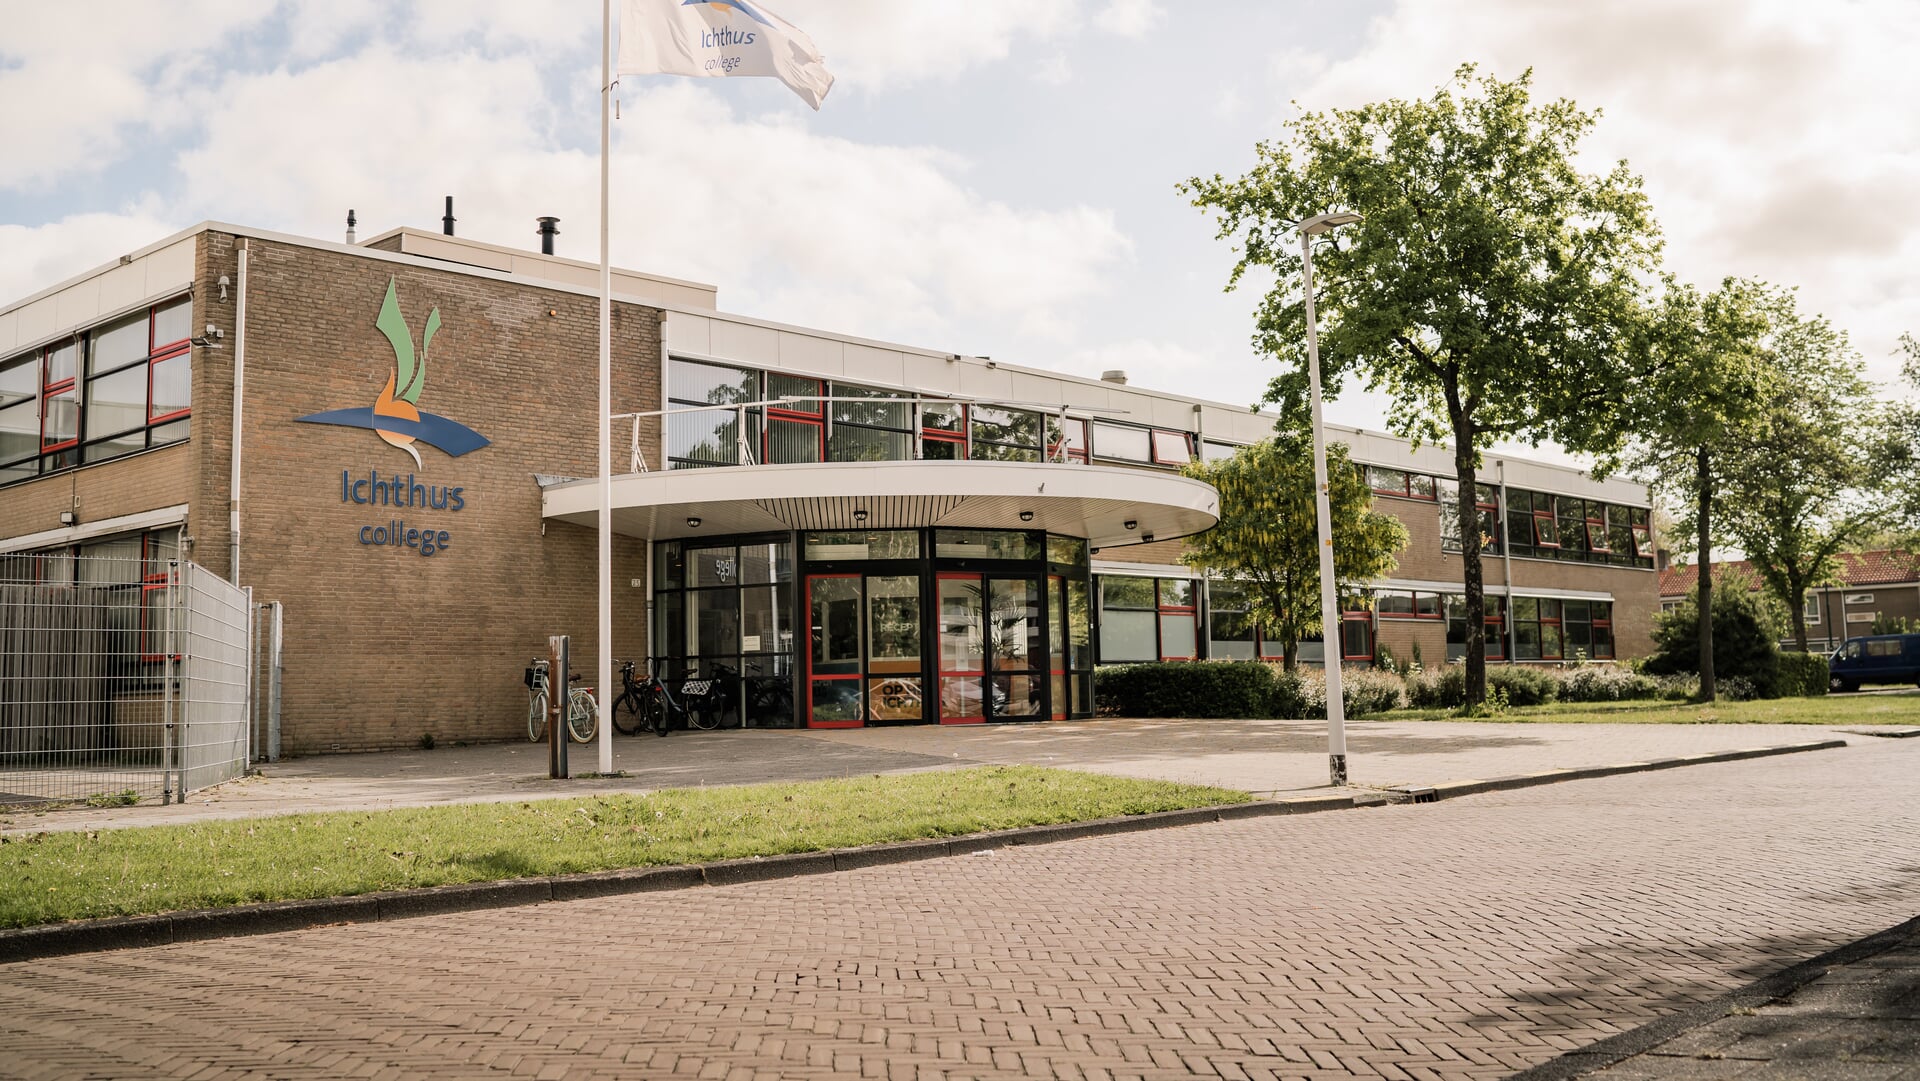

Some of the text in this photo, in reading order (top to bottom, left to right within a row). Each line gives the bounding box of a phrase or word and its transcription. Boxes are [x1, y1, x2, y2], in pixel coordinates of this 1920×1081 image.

[702, 25, 756, 49] Ichthus
[704, 55, 741, 73] college
[342, 469, 465, 511] Ichthus
[359, 519, 450, 556] college
